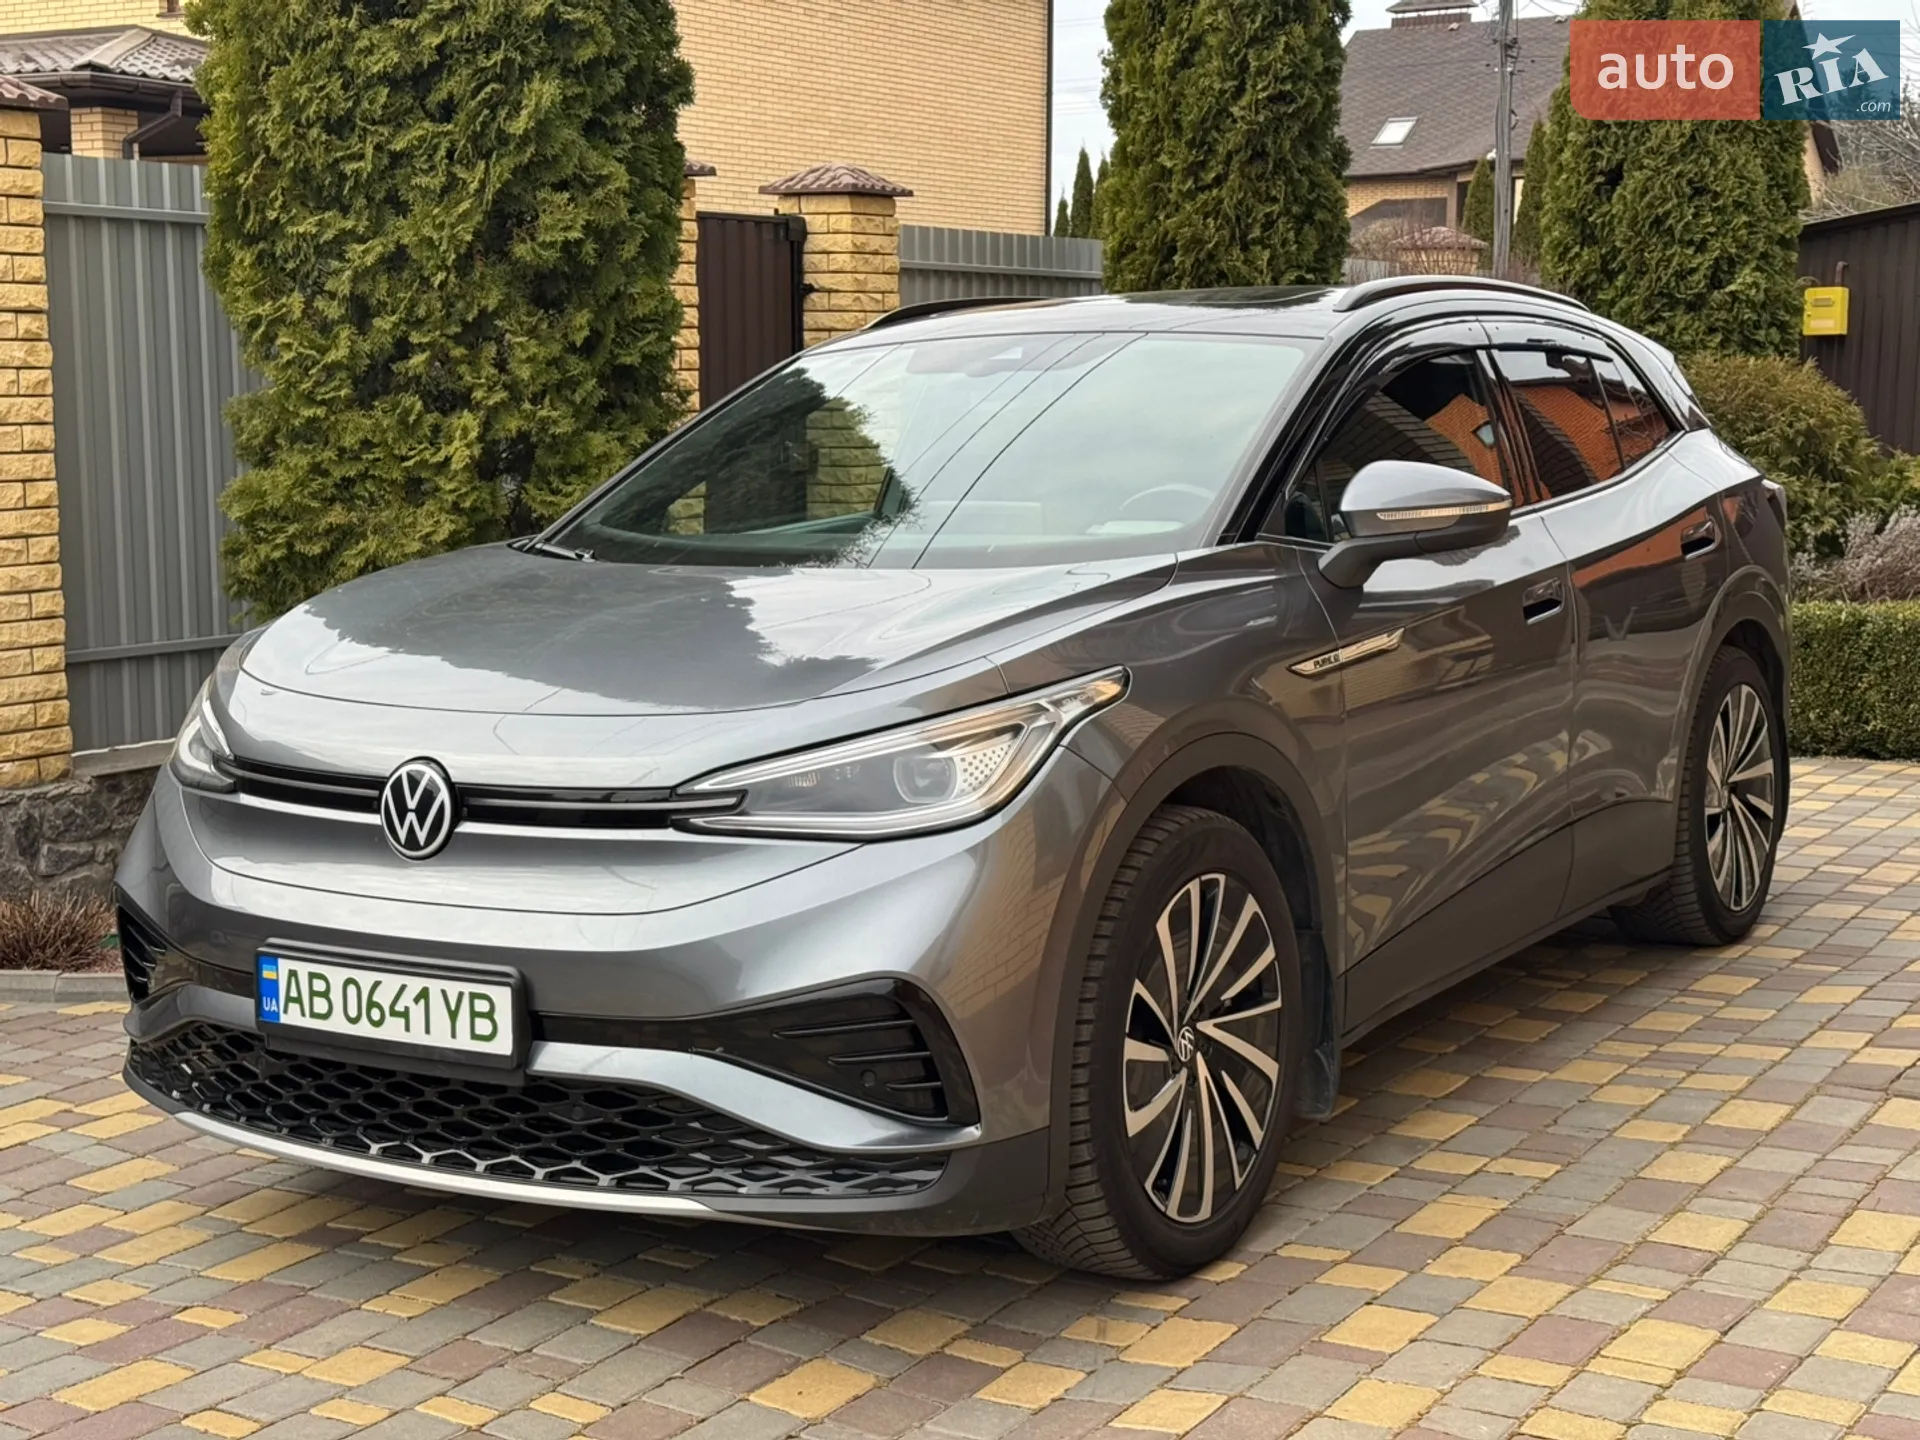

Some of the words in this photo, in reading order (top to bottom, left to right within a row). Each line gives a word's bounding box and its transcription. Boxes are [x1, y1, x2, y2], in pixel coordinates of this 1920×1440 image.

[263, 996, 278, 1013] UA
[284, 969, 334, 1021] AB
[342, 977, 431, 1035] 0641
[441, 988, 499, 1042] YB
